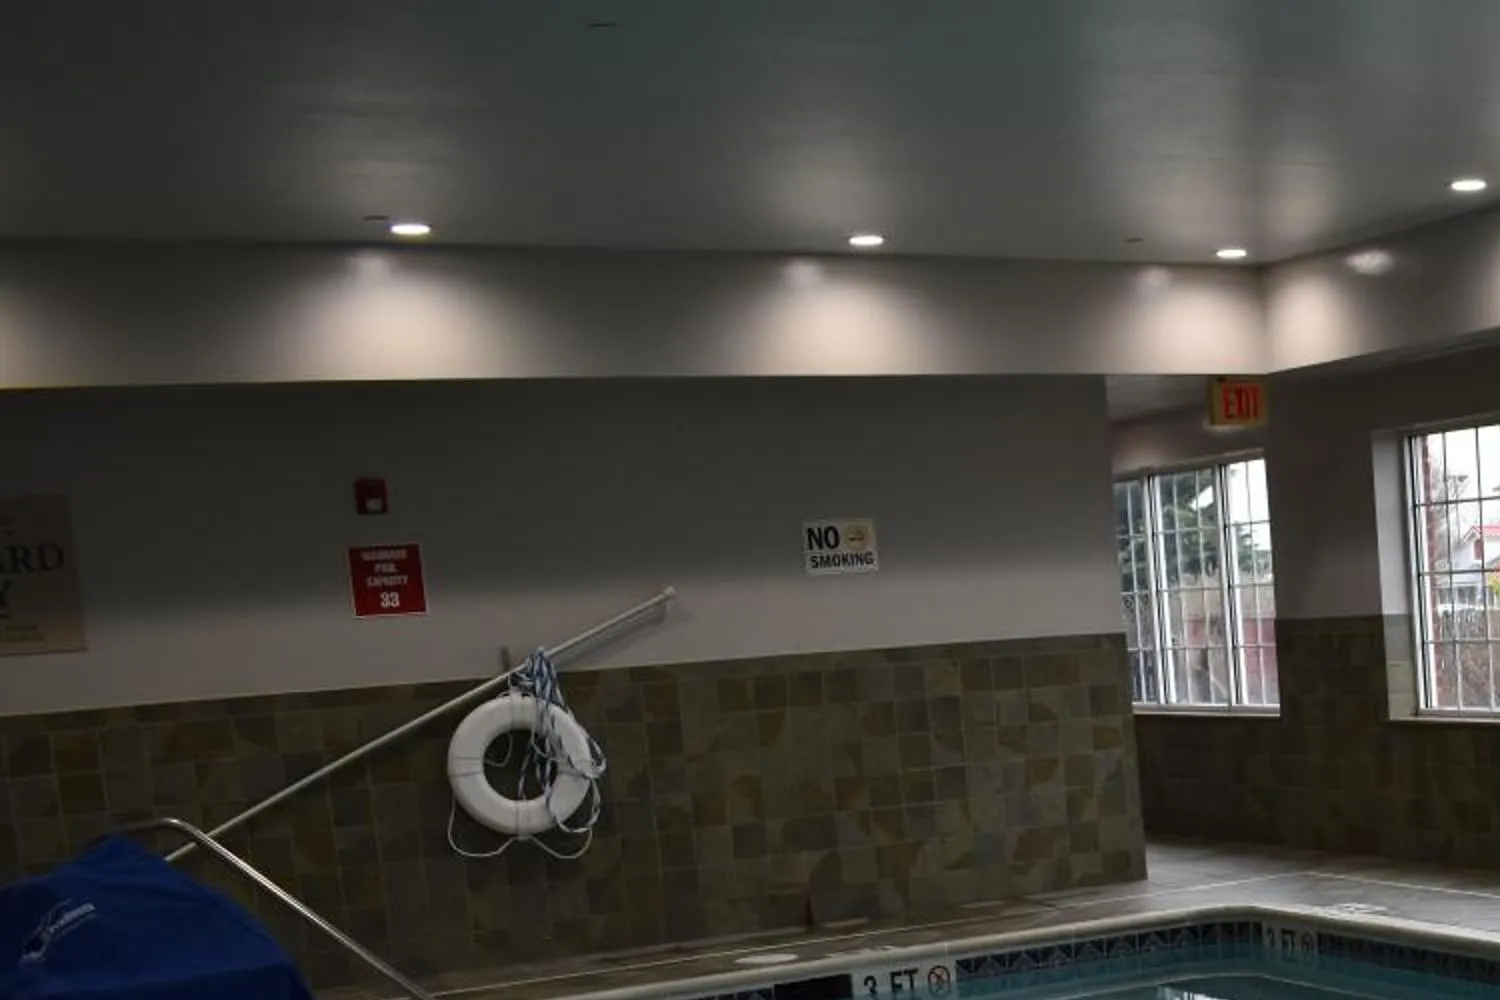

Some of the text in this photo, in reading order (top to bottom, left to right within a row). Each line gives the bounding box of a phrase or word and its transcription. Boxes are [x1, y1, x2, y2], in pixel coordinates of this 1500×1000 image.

[1222, 386, 1260, 419] EXIT
[807, 525, 840, 550] NO
[810, 551, 874, 569] SMOKING
[380, 591, 400, 609] 33
[863, 968, 919, 994] 3 FT
